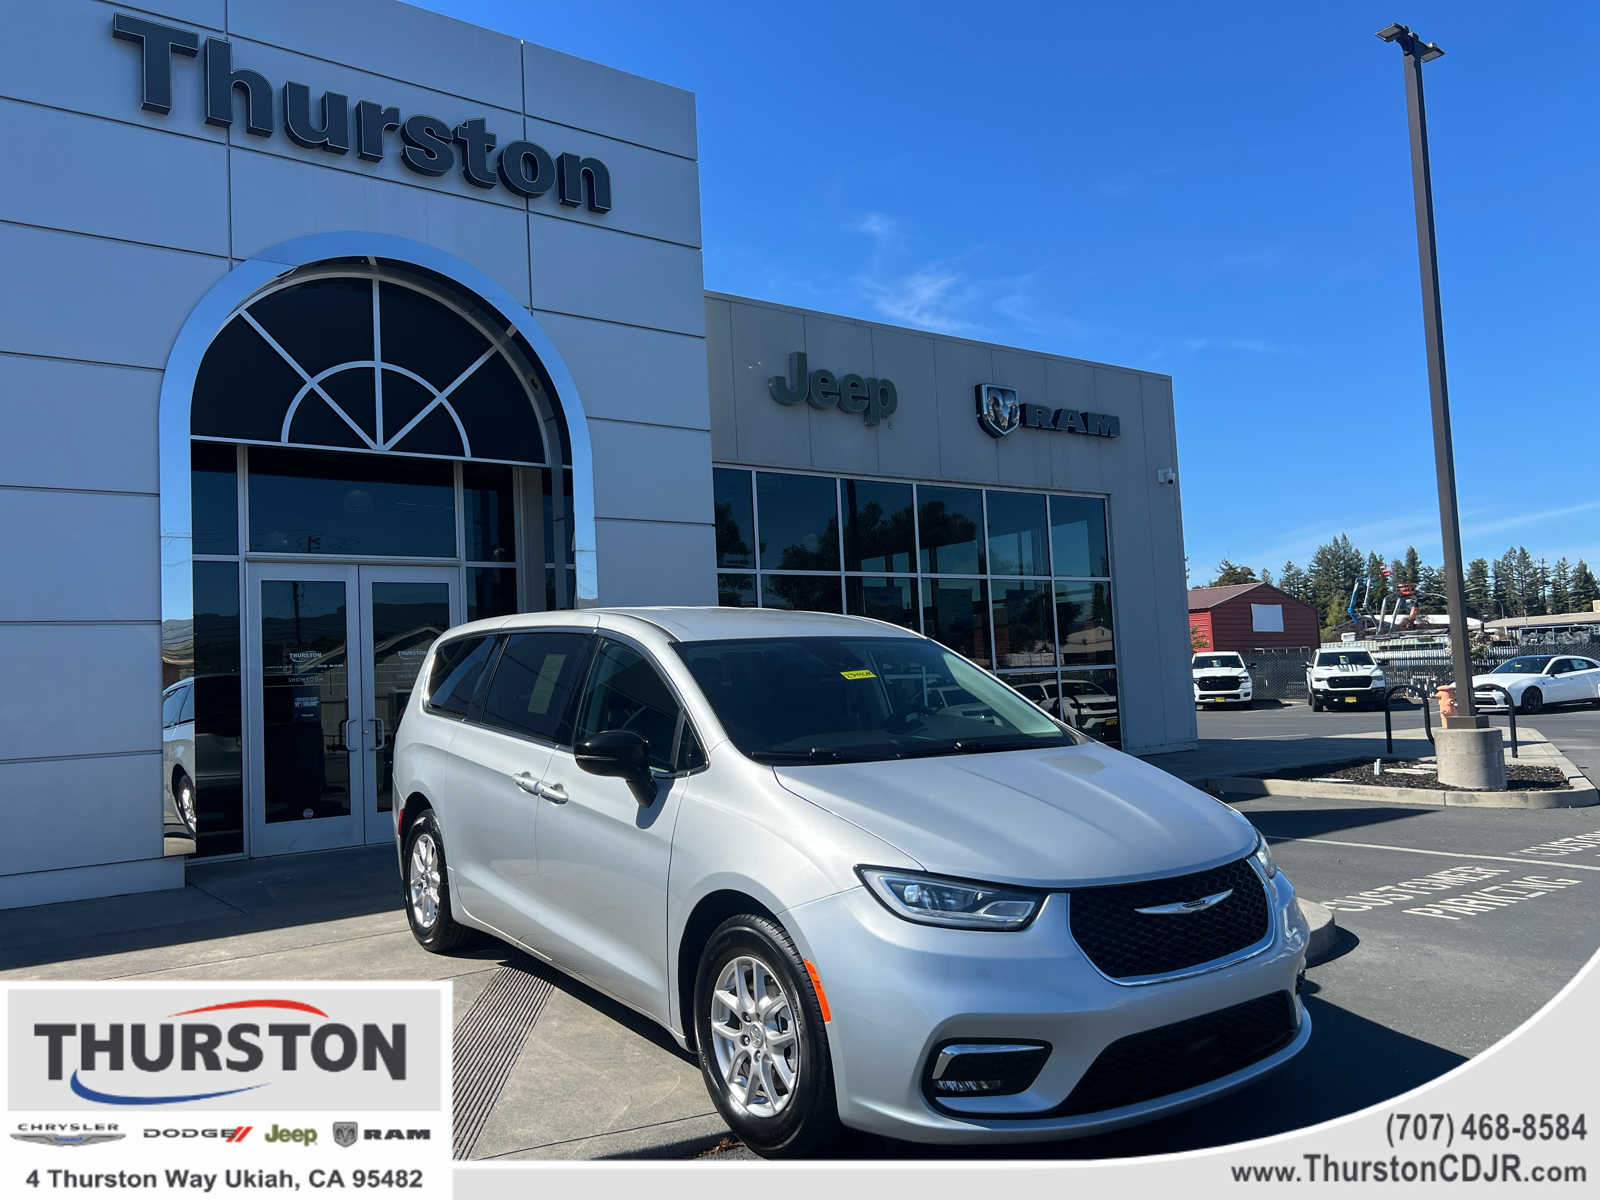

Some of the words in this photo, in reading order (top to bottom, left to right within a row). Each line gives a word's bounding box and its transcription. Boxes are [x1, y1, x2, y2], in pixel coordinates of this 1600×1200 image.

[112, 12, 611, 214] Thurston
[768, 352, 898, 426] Jeep
[1018, 403, 1120, 438] RAM
[1320, 866, 1509, 911] CUSTOMER
[1402, 876, 1583, 920] PARKING
